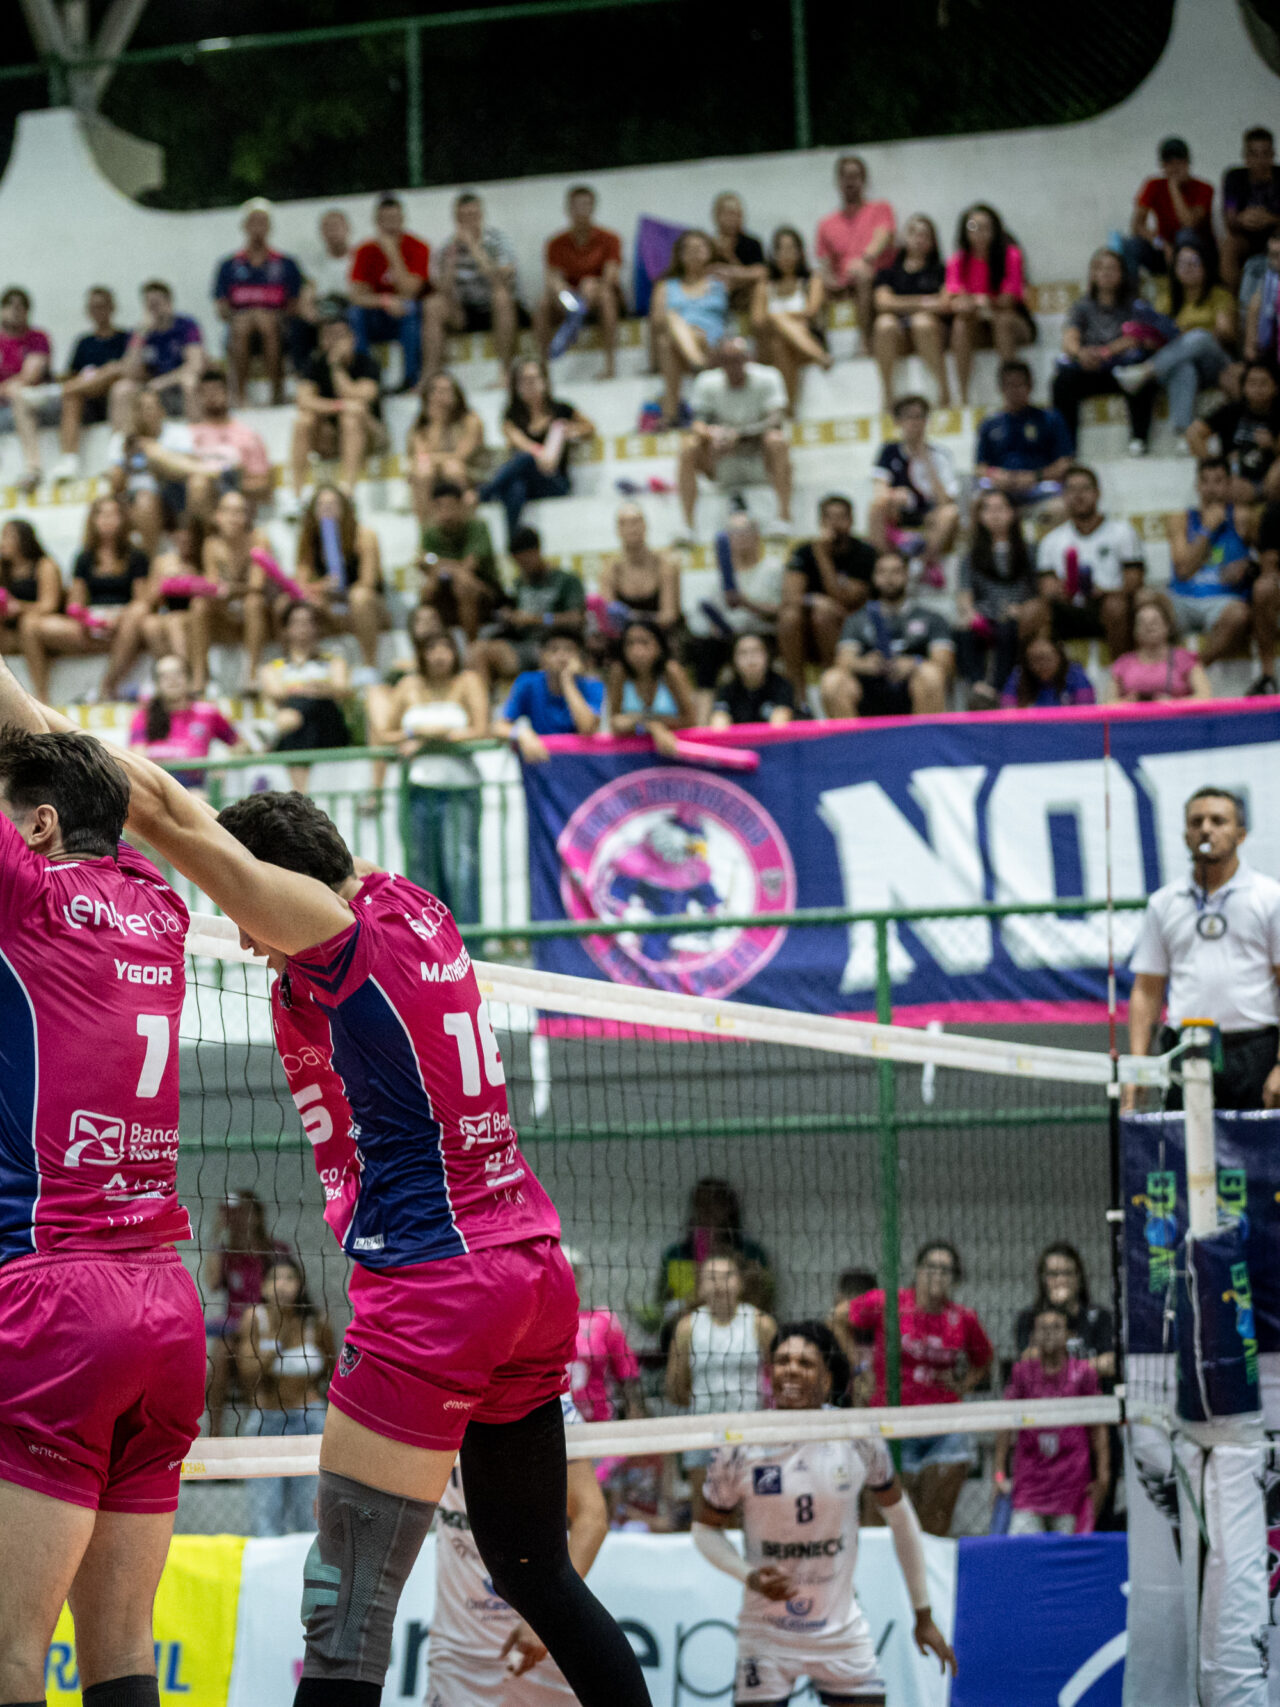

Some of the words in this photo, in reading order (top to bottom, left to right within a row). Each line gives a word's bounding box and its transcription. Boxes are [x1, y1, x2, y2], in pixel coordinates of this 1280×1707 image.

[114, 958, 172, 985] YGOR
[130, 1122, 179, 1143] Banco
[796, 1494, 814, 1524] 8
